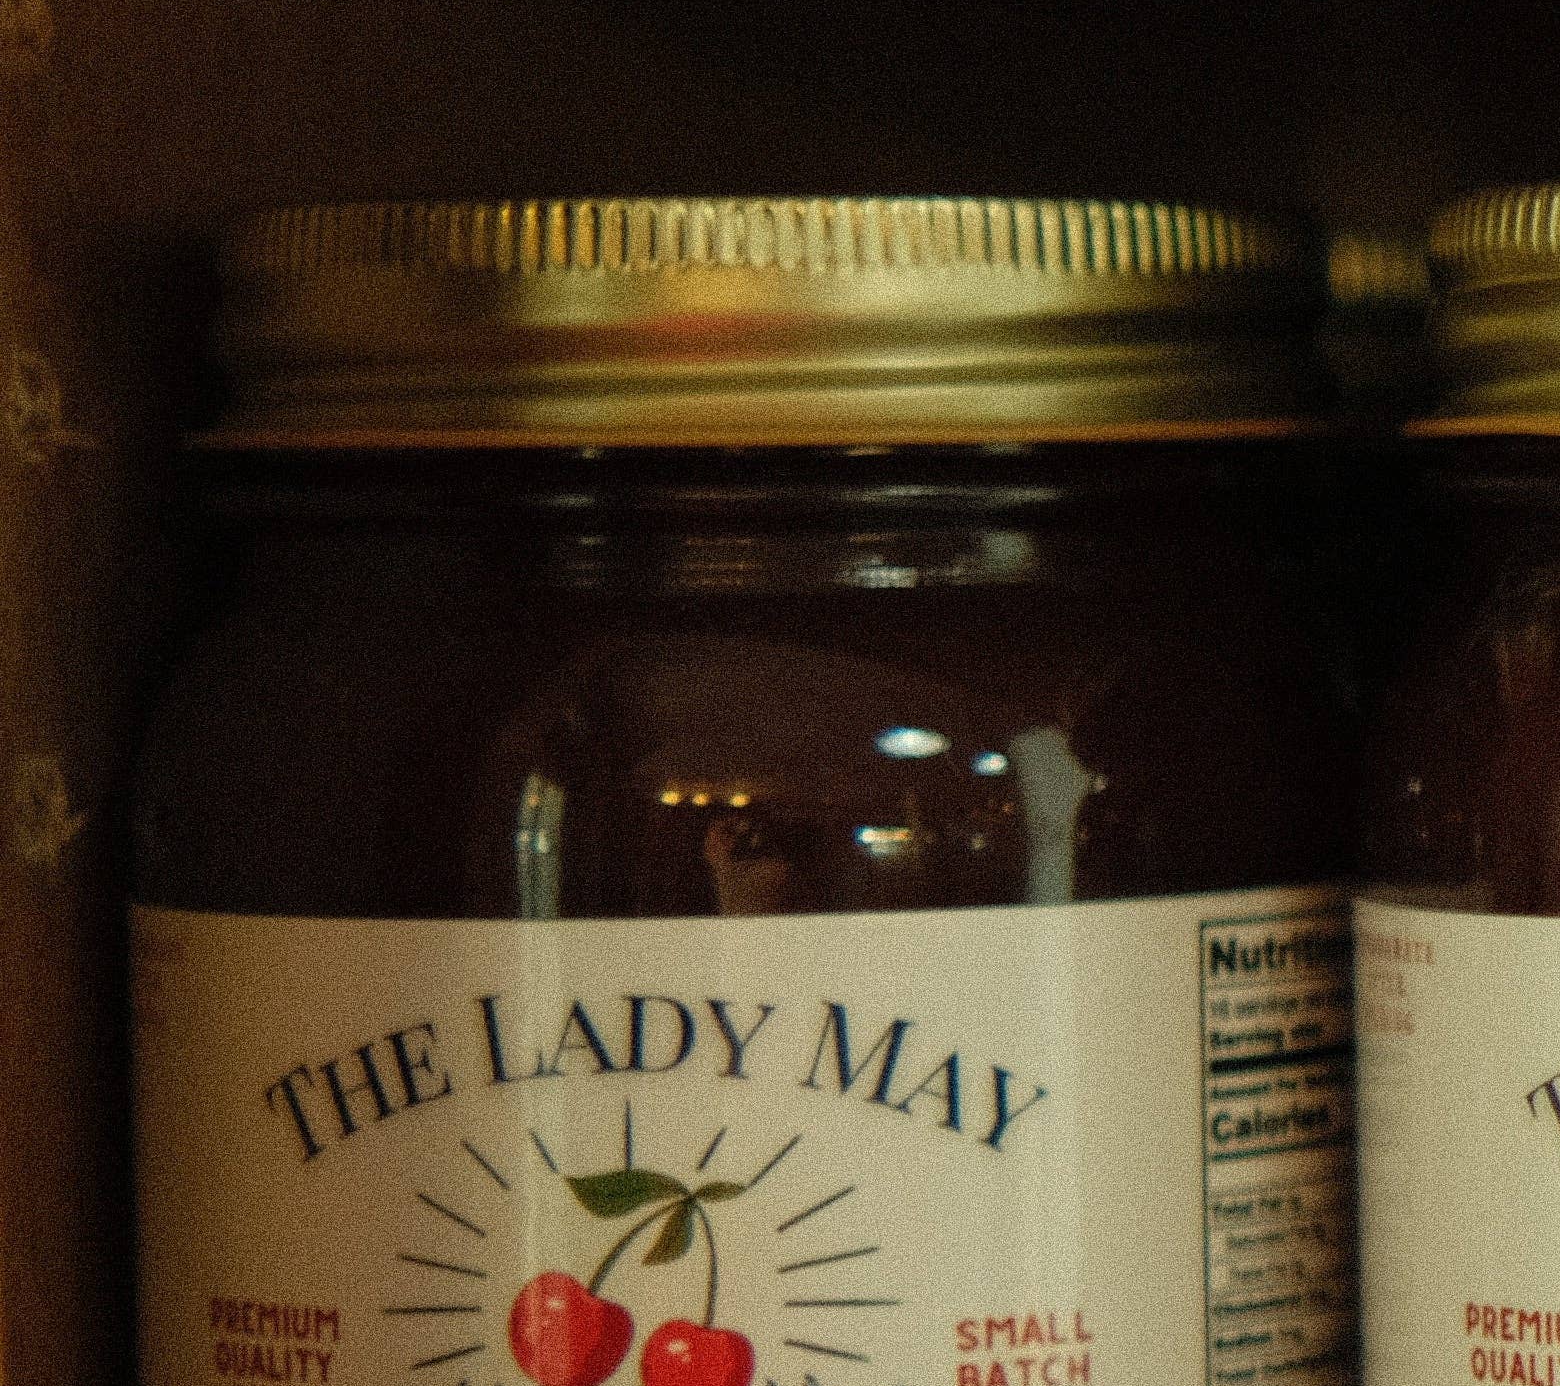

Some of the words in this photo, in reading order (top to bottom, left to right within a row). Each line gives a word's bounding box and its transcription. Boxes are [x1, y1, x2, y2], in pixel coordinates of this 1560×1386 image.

[266, 1023, 452, 1162] THE
[480, 995, 774, 1084] LADY
[801, 1001, 1050, 1153] MAY
[207, 1296, 341, 1344] PREMIUM
[955, 1314, 1095, 1353] SMALL
[212, 1340, 336, 1385] QUALITY
